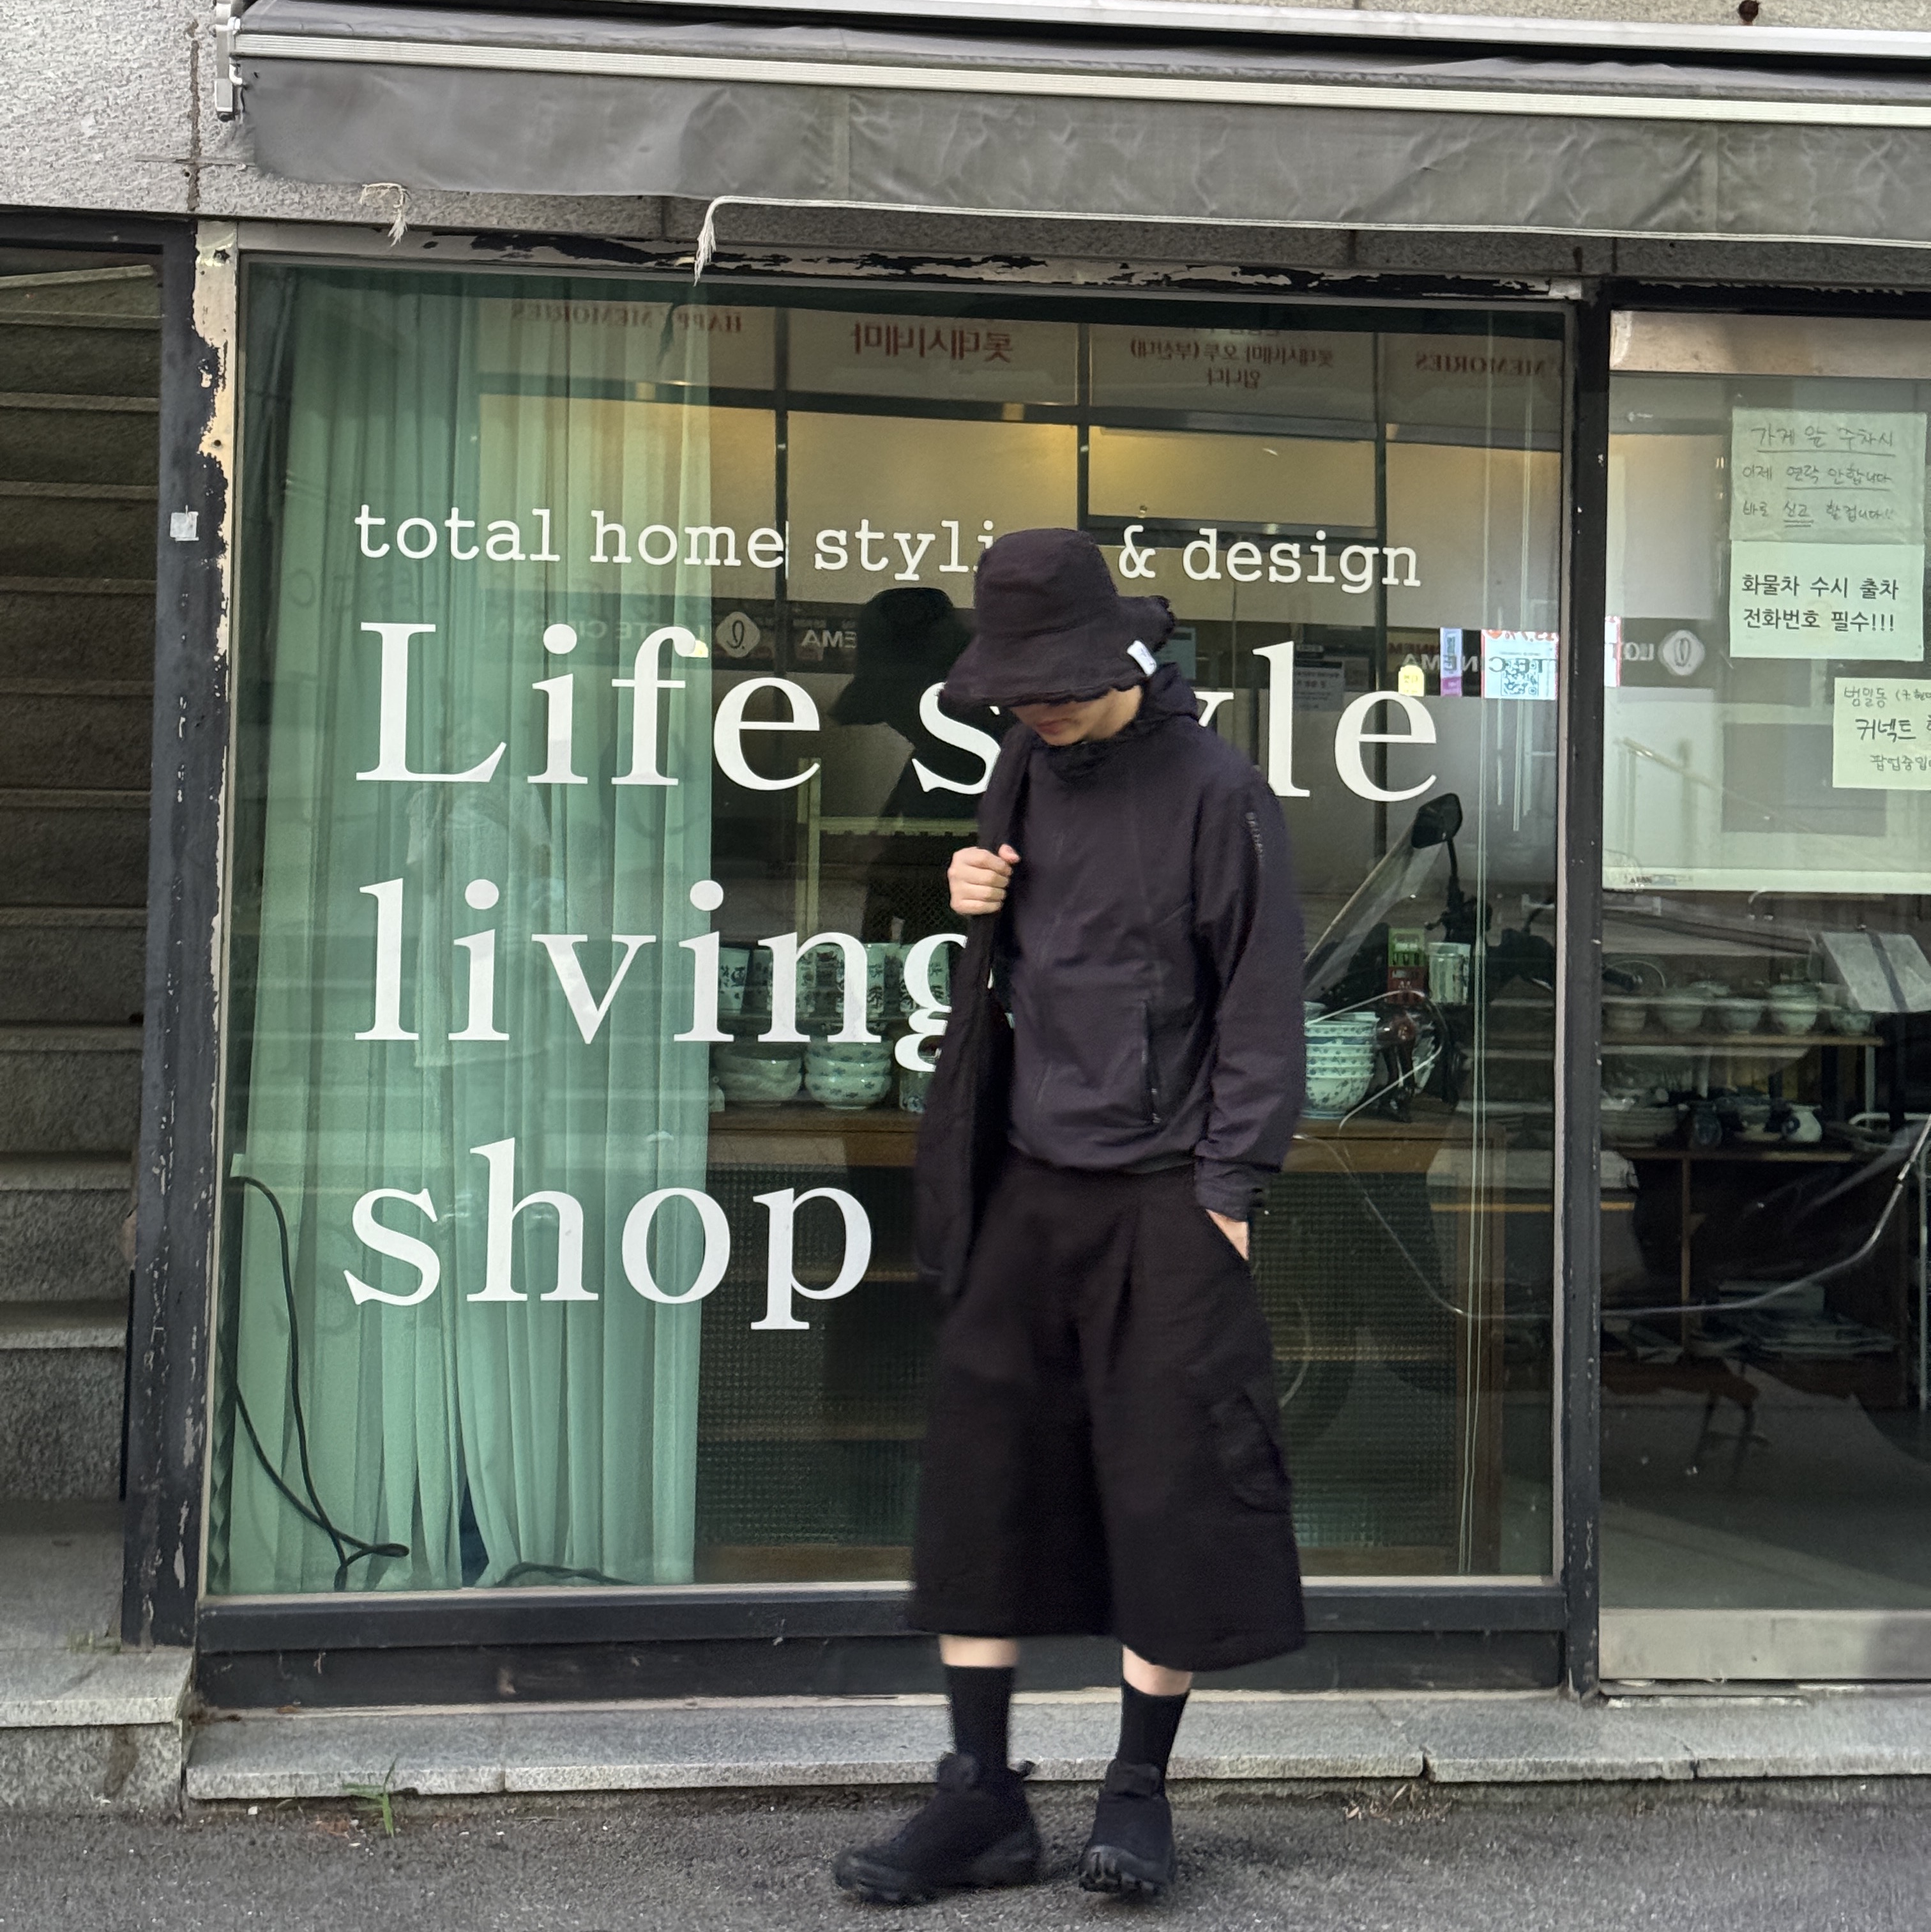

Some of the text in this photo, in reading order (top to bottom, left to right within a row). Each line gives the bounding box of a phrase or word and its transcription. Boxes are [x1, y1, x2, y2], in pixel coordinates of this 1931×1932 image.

[1750, 422, 1795, 447] 가게
[1836, 425, 1893, 450] 주차시
[1741, 464, 1773, 481] 이제
[1786, 464, 1820, 484] 연락
[1741, 499, 1769, 517] 바로
[1783, 499, 1813, 518] 신고
[354, 504, 1421, 595] total home styli & design
[1741, 573, 1899, 601] 화물차 수시 출차
[1743, 609, 1896, 633] 전화번호 필수!!!
[1843, 685, 1888, 708] 범일동
[355, 621, 821, 790] Life
[911, 641, 1437, 802] sle
[1854, 717, 1918, 743] 커넥트
[343, 1137, 872, 1330] shop
